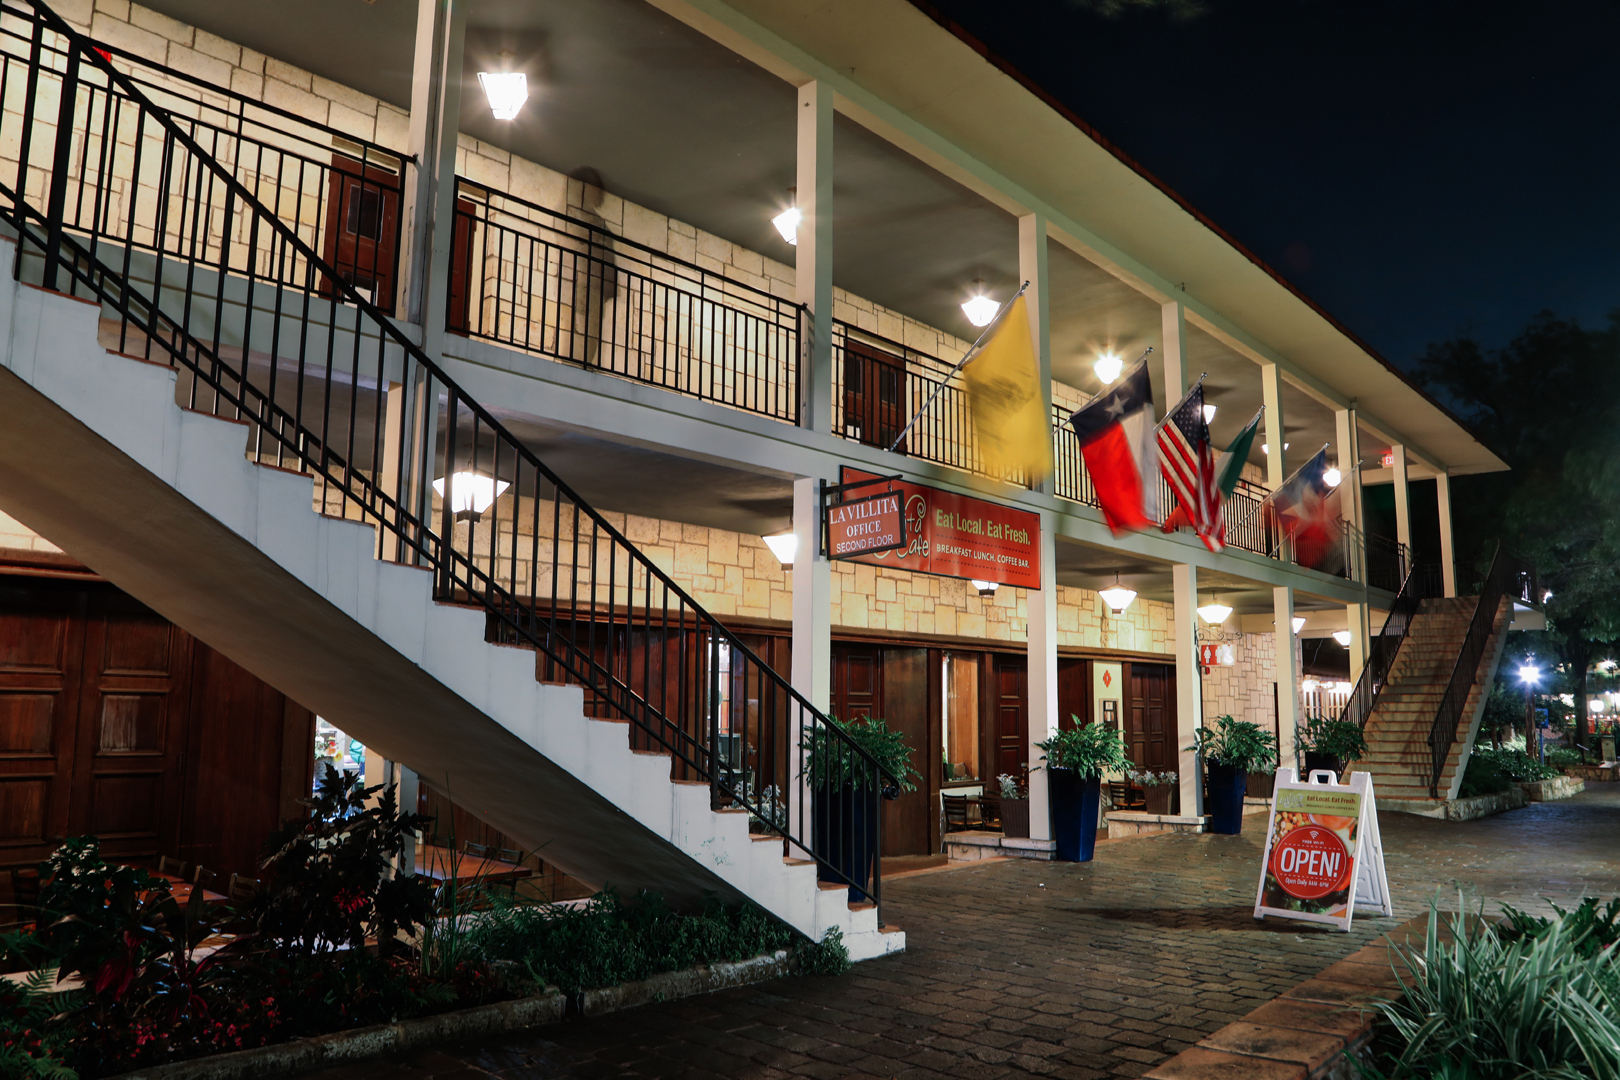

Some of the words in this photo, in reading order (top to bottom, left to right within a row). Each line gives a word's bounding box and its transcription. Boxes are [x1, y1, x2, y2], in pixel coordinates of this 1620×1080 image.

[830, 508, 846, 525] LA
[847, 497, 899, 520] VILLITA
[846, 520, 882, 537] OFFICE
[936, 509, 954, 529] Eat
[957, 513, 985, 535] Local.
[987, 520, 1003, 539] Eat
[1005, 524, 1031, 545] Fresh.
[836, 539, 867, 553] SECOND
[868, 534, 894, 548] FLOOR
[936, 543, 972, 558] BREAKFAST.
[973, 551, 996, 562] LUNCH.
[997, 554, 1018, 566] COFFEE
[1018, 558, 1030, 568] BAR.
[1280, 847, 1340, 878] OPEN!
[1297, 878, 1308, 886] Daily
